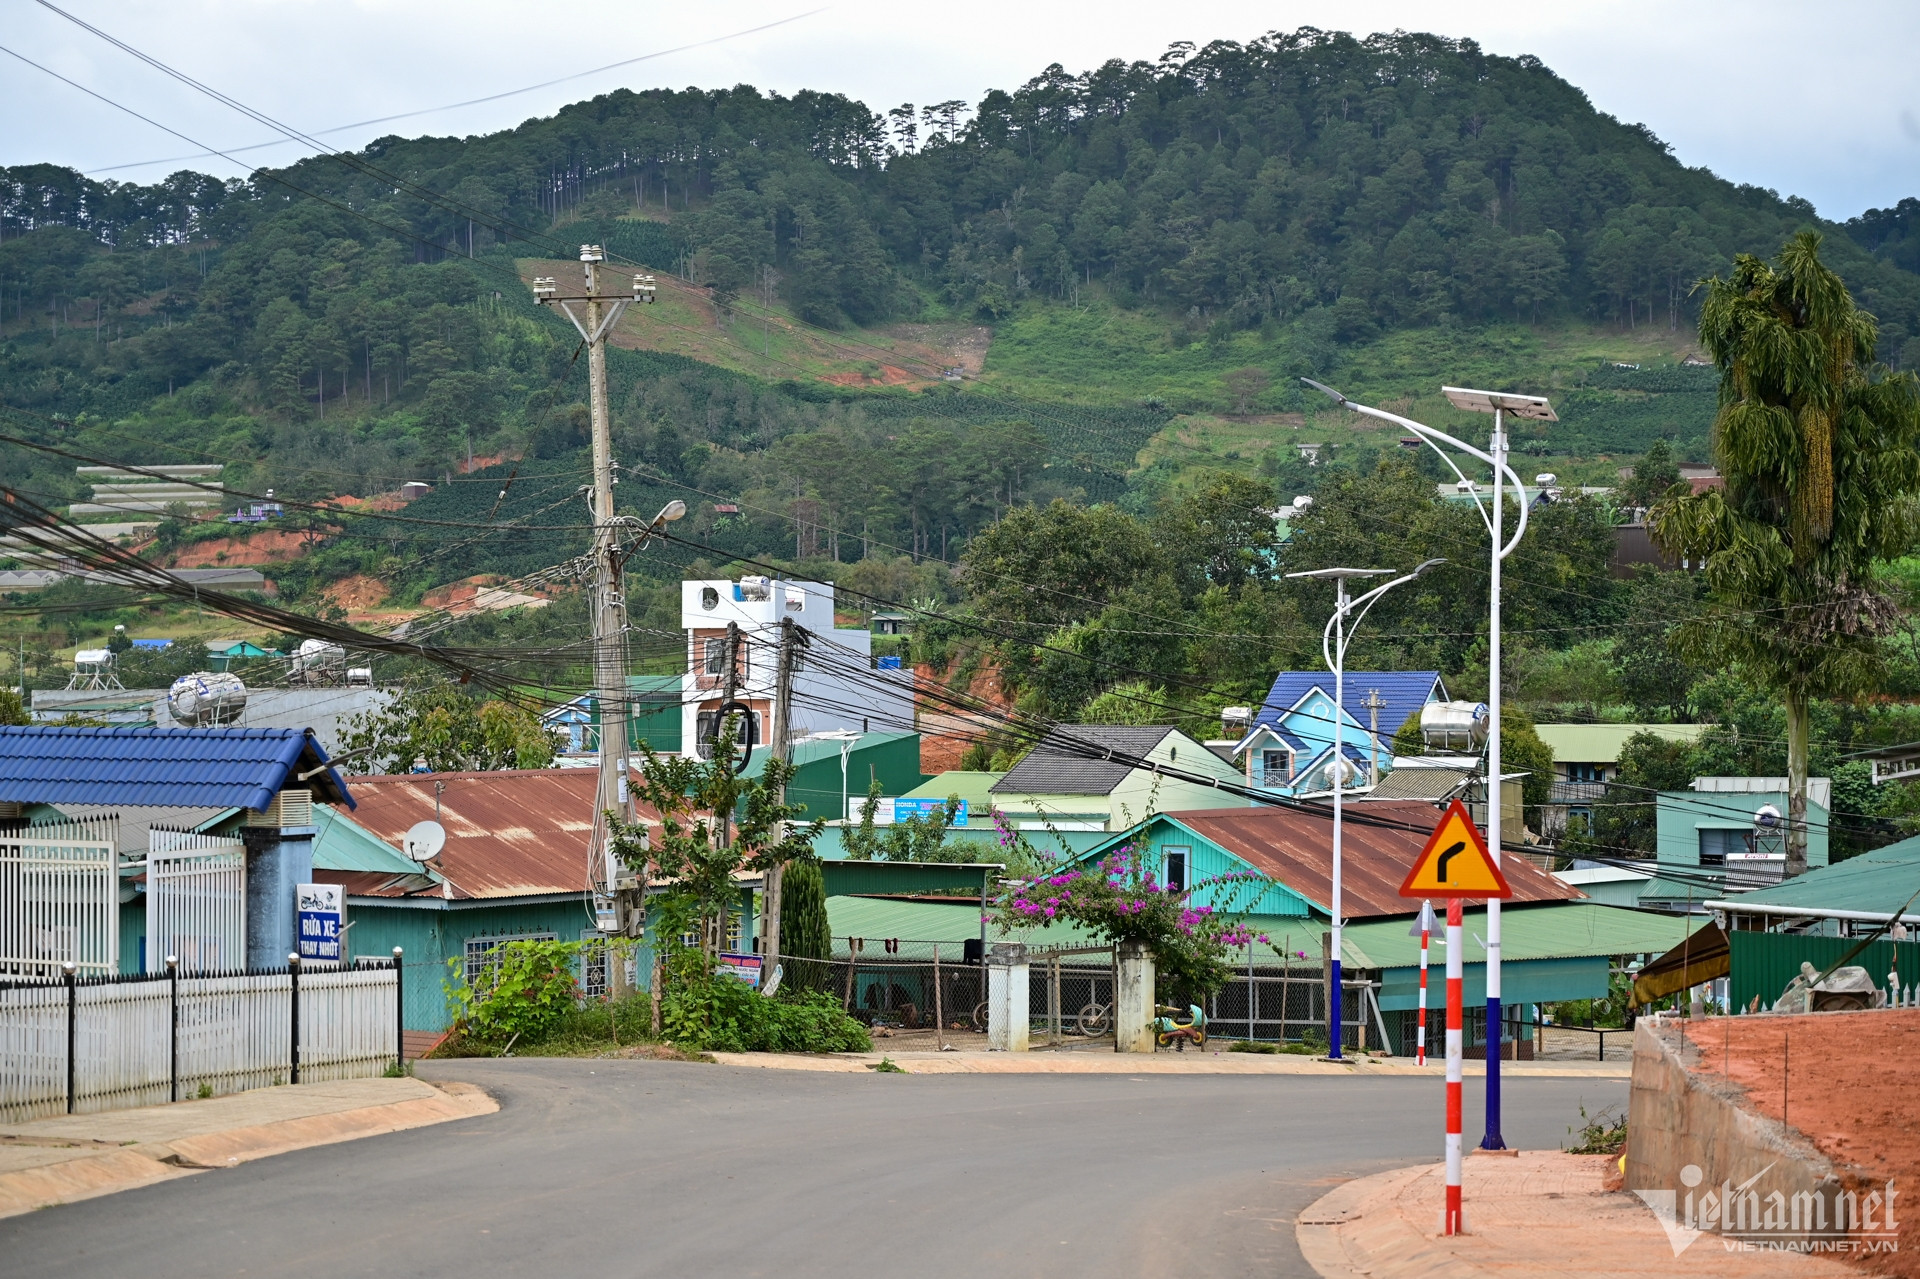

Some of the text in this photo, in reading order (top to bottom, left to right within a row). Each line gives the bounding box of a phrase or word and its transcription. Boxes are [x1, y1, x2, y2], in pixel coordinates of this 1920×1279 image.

[303, 914, 335, 936] RỬA XE
[301, 941, 318, 955] THAY
